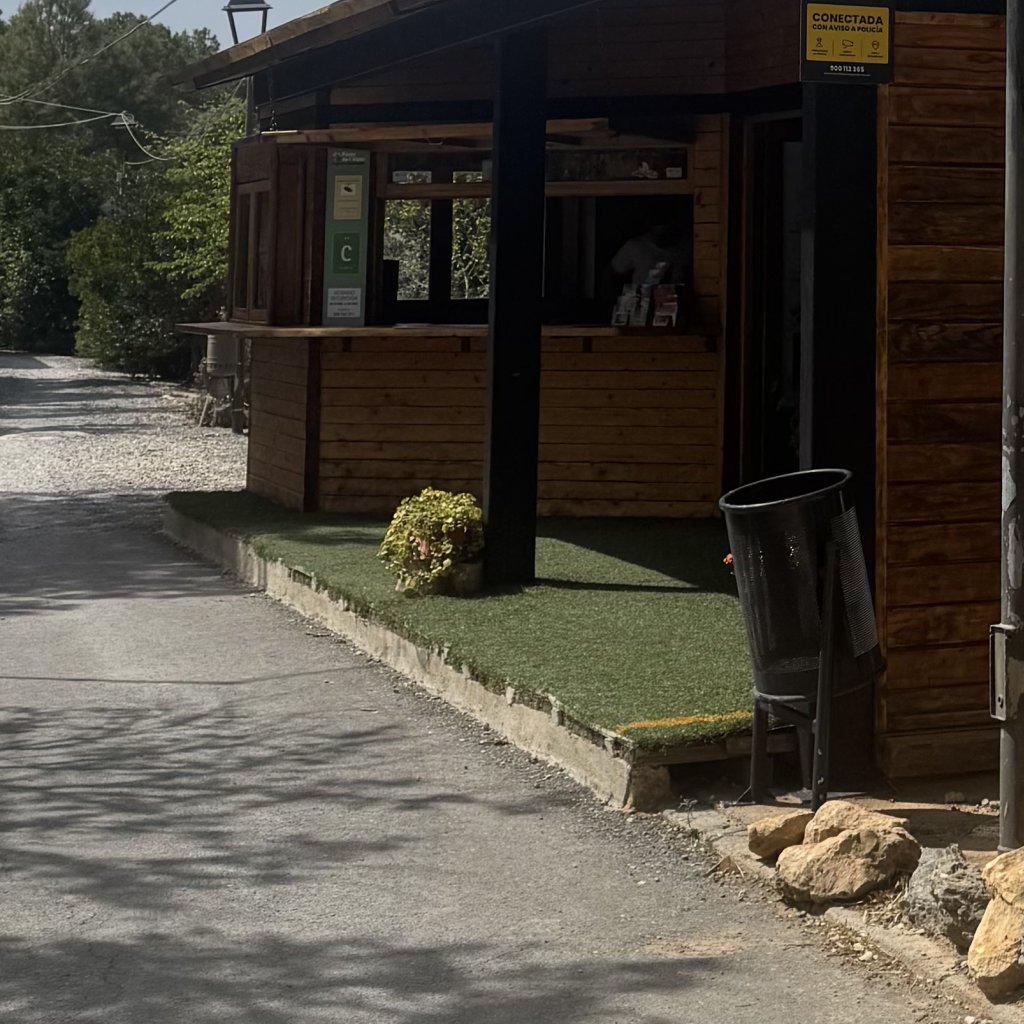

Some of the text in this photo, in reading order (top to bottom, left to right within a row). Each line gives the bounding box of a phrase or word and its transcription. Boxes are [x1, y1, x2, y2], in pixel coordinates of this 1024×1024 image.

[812, 13, 883, 25] CONECTADA
[812, 23, 828, 31] CON
[829, 24, 850, 32] AVISO
